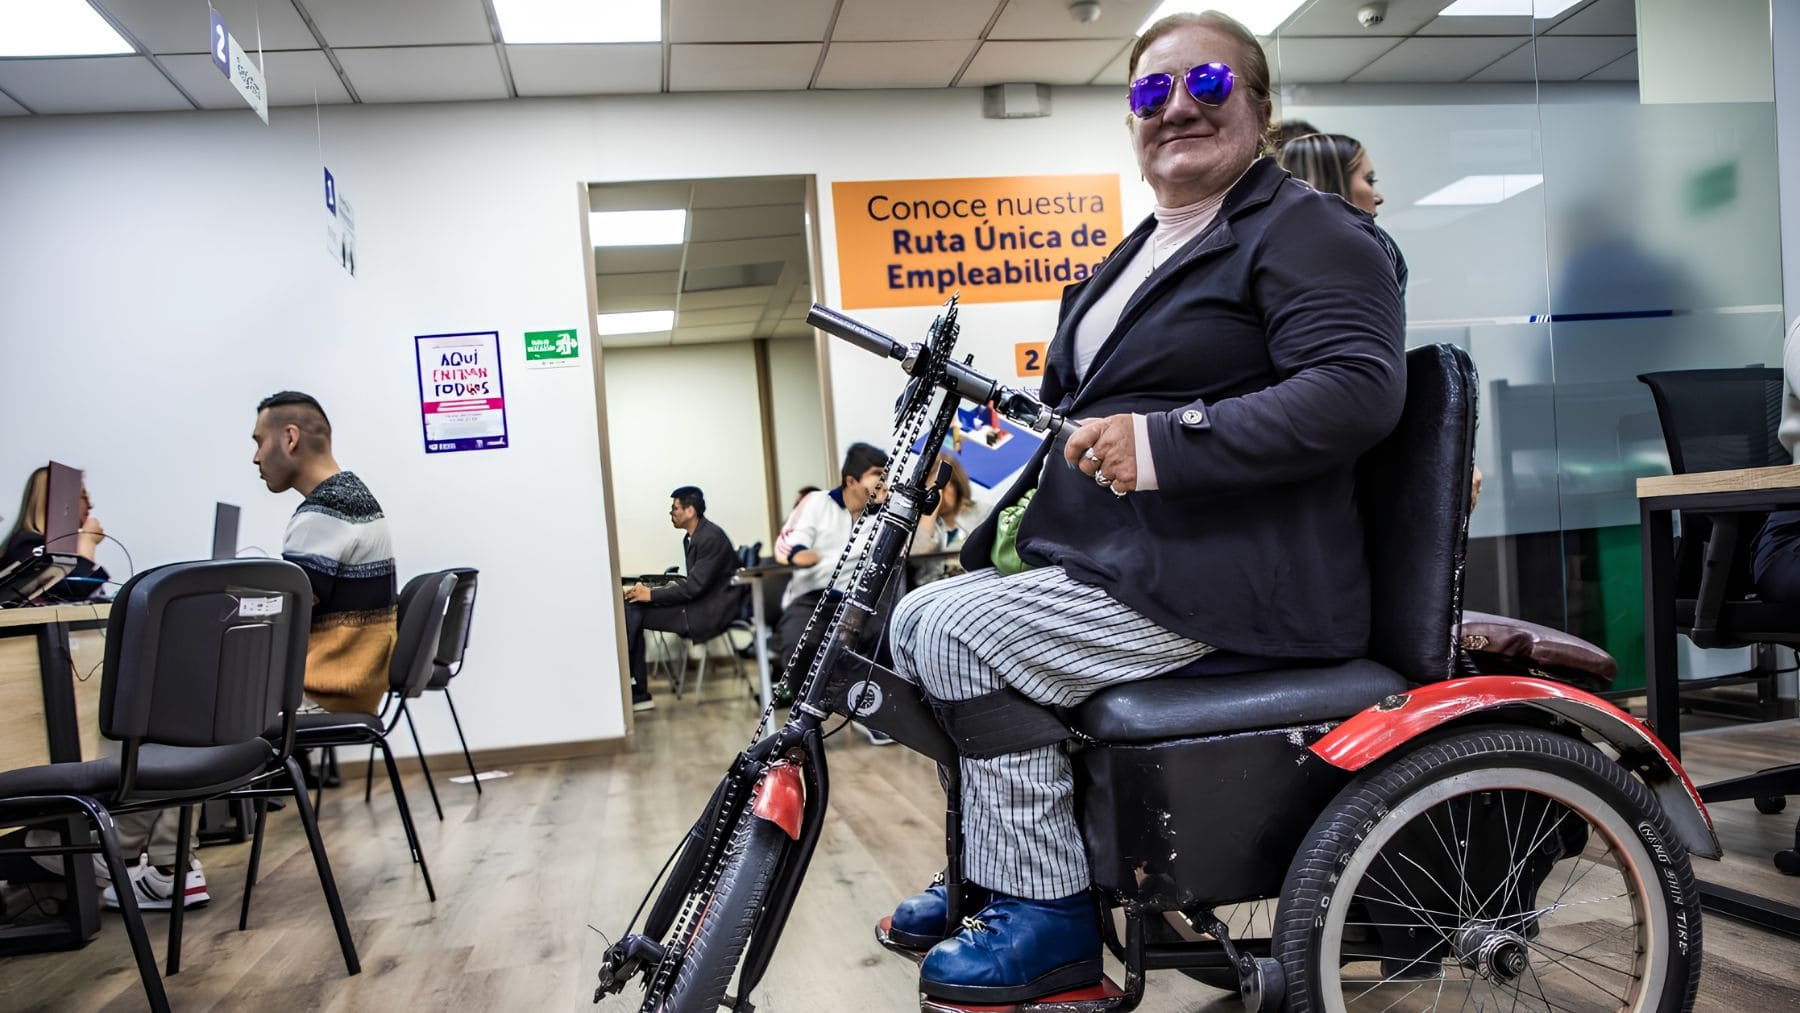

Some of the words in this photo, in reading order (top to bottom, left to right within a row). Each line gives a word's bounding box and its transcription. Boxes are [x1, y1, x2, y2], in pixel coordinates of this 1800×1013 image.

[215, 24, 226, 63] 2
[867, 195, 987, 221] Conoce
[997, 191, 1105, 216] nuestra
[892, 229, 966, 255] Ruta
[974, 219, 1062, 252] Única
[1071, 224, 1107, 247] de
[1024, 349, 1040, 371] 2
